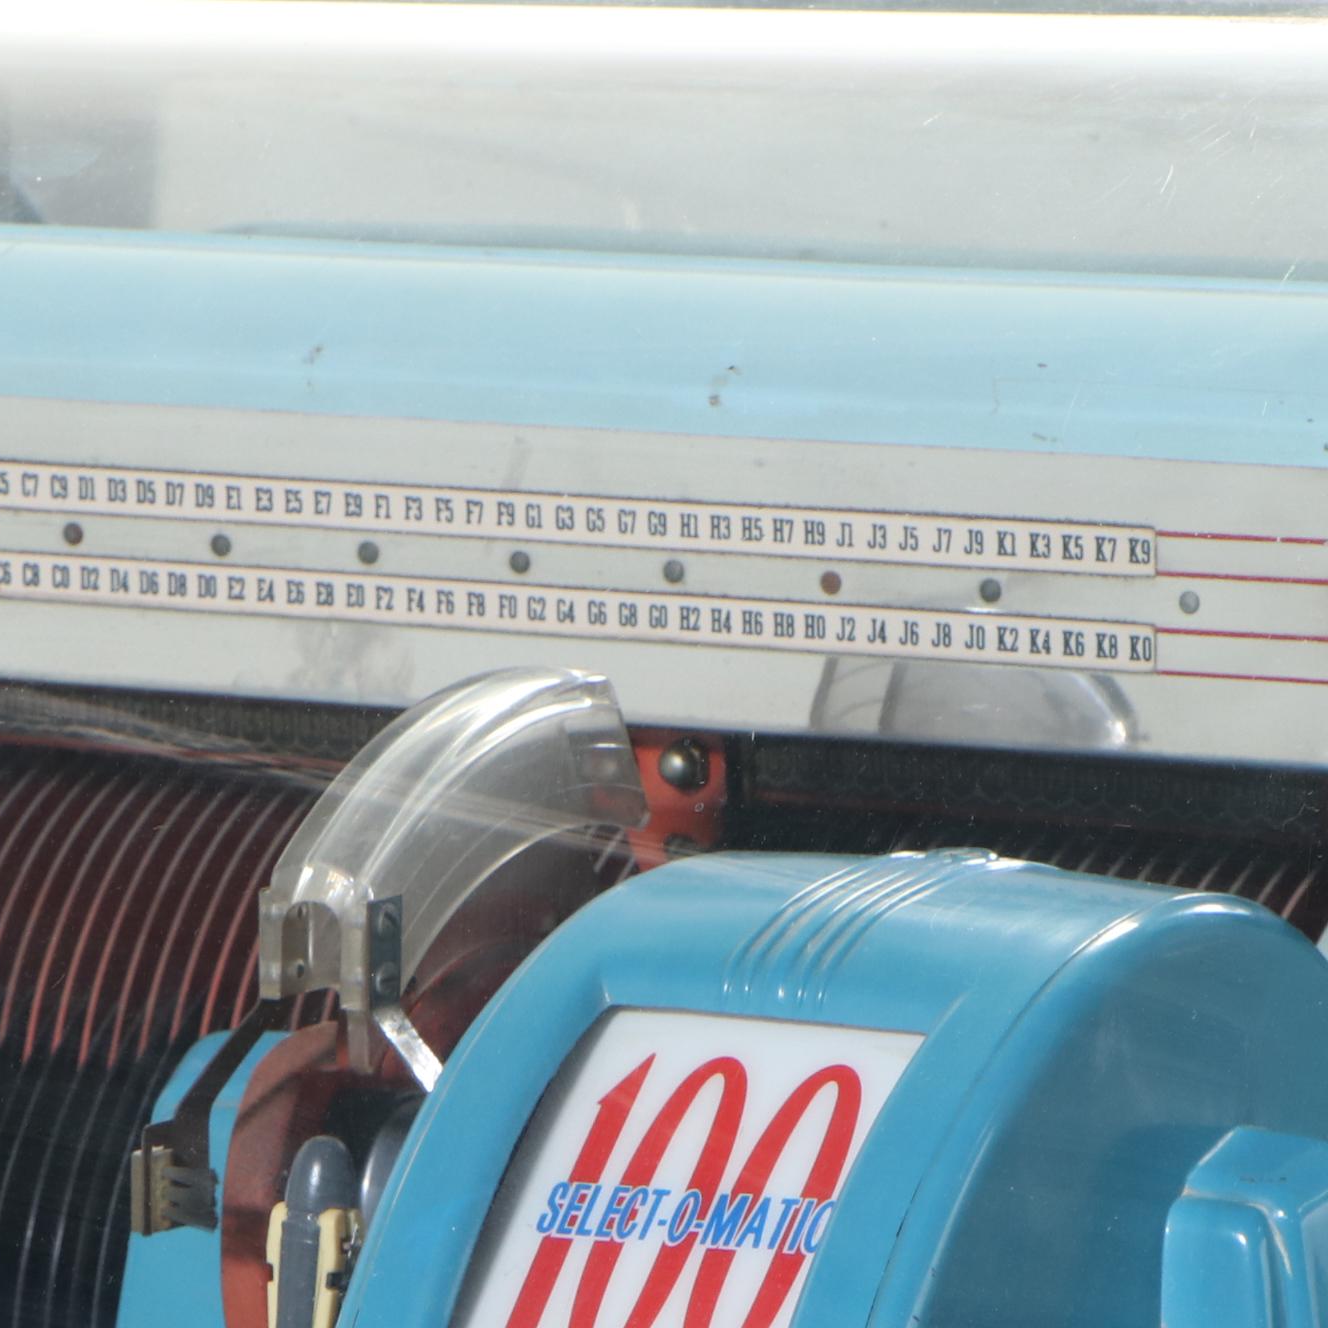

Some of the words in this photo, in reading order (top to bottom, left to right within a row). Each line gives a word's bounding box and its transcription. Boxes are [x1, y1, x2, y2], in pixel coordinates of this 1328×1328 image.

[20, 472, 39, 497] C7
[49, 474, 69, 500] C9
[77, 476, 96, 502] D1
[107, 477, 128, 504] D3
[135, 480, 157, 505] D5
[165, 481, 185, 506] D7
[194, 483, 215, 508] D9
[225, 485, 242, 511] E1
[254, 487, 274, 513] E3
[284, 489, 303, 515] E5
[313, 491, 332, 516] E7
[344, 492, 363, 518] E9
[374, 494, 391, 519] F1
[404, 495, 423, 521] F3
[434, 497, 454, 523] F5
[465, 499, 484, 526] F7
[496, 501, 516, 527] F9
[524, 503, 543, 529] G1
[554, 504, 575, 531] G3
[585, 507, 606, 533] G5
[617, 508, 637, 535] G7
[647, 510, 668, 537] G9
[679, 513, 699, 539] H1
[709, 515, 732, 541] H3
[741, 517, 764, 543] H5
[772, 517, 794, 544] H7
[803, 519, 826, 546] H9
[835, 522, 854, 548] J1
[866, 523, 888, 550] J3
[898, 525, 919, 552] J5
[932, 527, 953, 554] J7
[963, 529, 985, 556] J9
[996, 530, 1017, 557] K1
[1028, 532, 1052, 559] K3
[1061, 534, 1085, 561] K5
[1094, 535, 1118, 563] K7
[1127, 536, 1151, 565] K9
[866, 618, 888, 645] J4
[898, 620, 920, 647] J6
[931, 622, 953, 649] J8
[964, 623, 986, 650] J0
[996, 626, 1019, 654] K2
[1028, 628, 1052, 656] K4
[1061, 630, 1086, 658] K6
[1095, 632, 1119, 659] K8
[1128, 635, 1151, 663] K0
[537, 1182, 838, 1256] SELECT-O-MATIC
